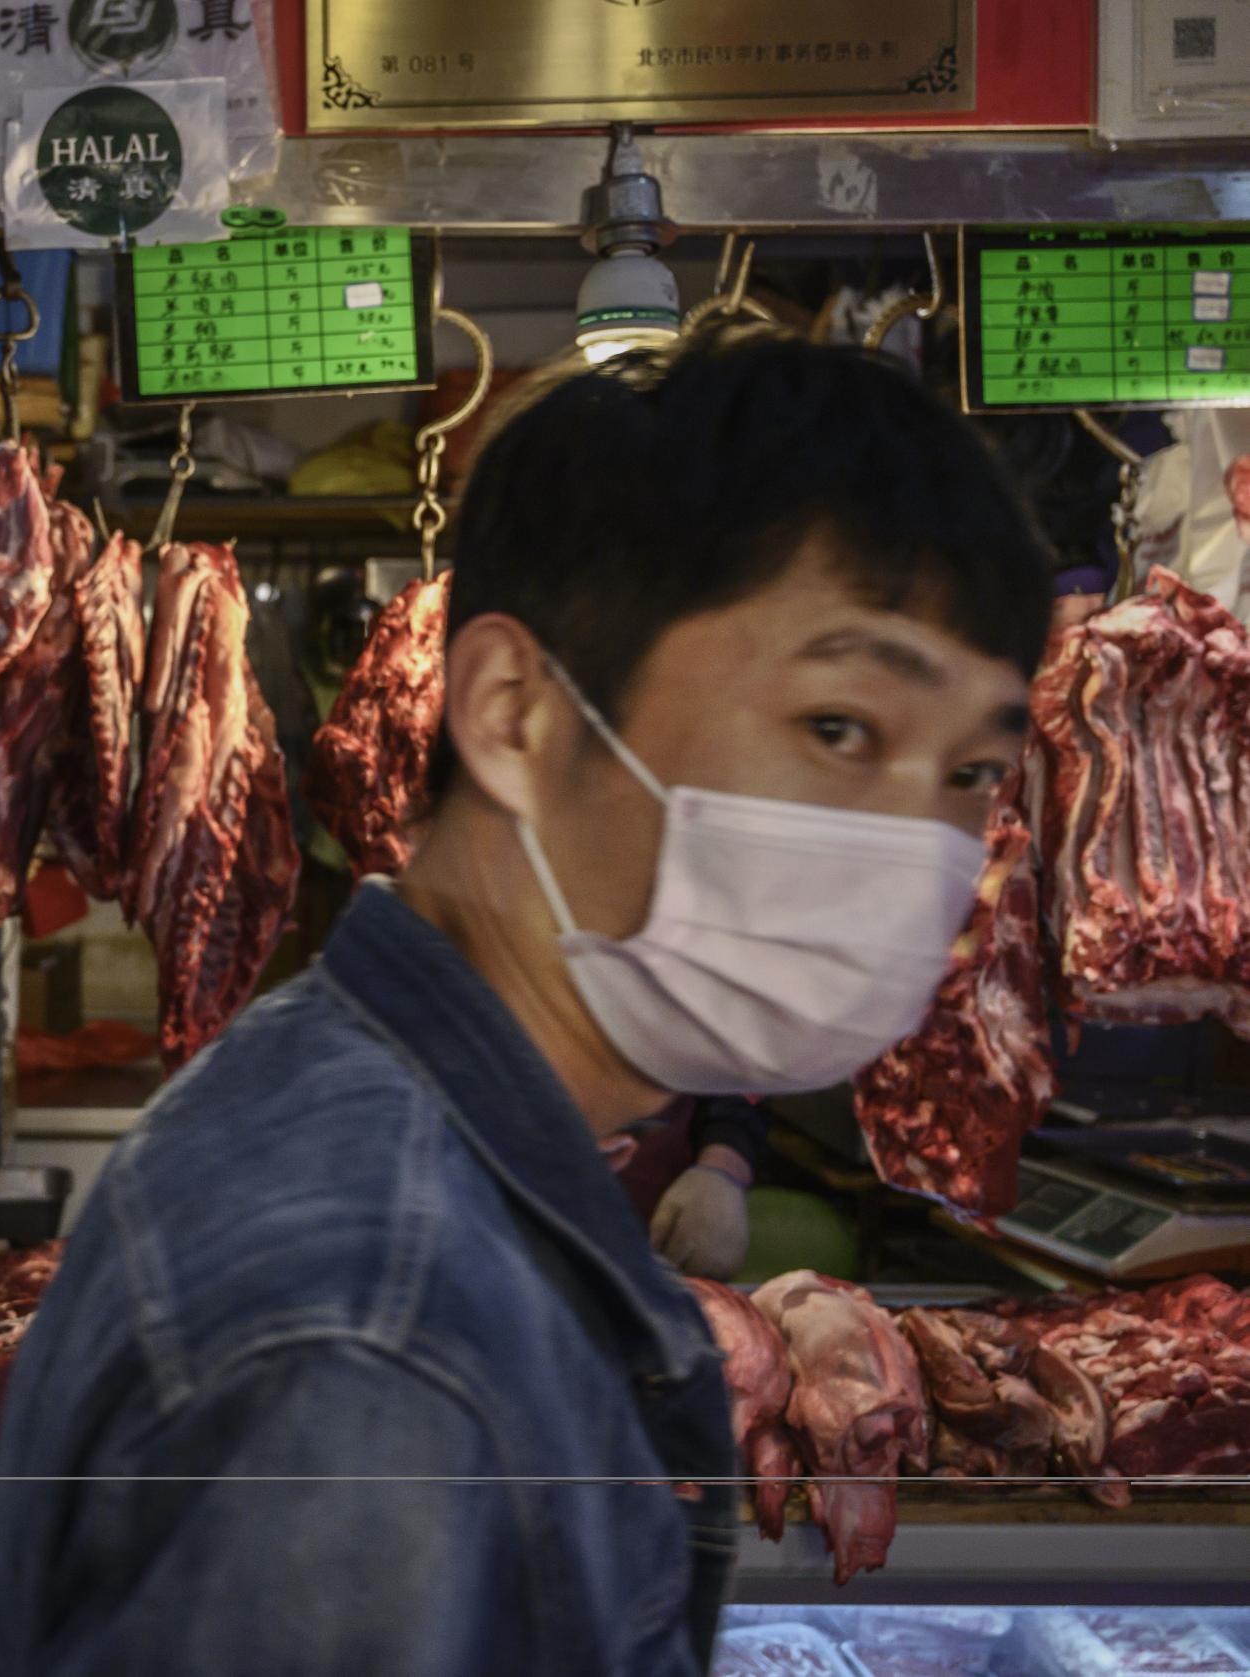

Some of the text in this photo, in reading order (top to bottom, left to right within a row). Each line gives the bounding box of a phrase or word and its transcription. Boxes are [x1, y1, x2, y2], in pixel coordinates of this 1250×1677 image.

[0, 2, 59, 55] 清
[408, 54, 448, 75] 081
[51, 132, 169, 167] HALAL
[274, 241, 308, 258] 单位
